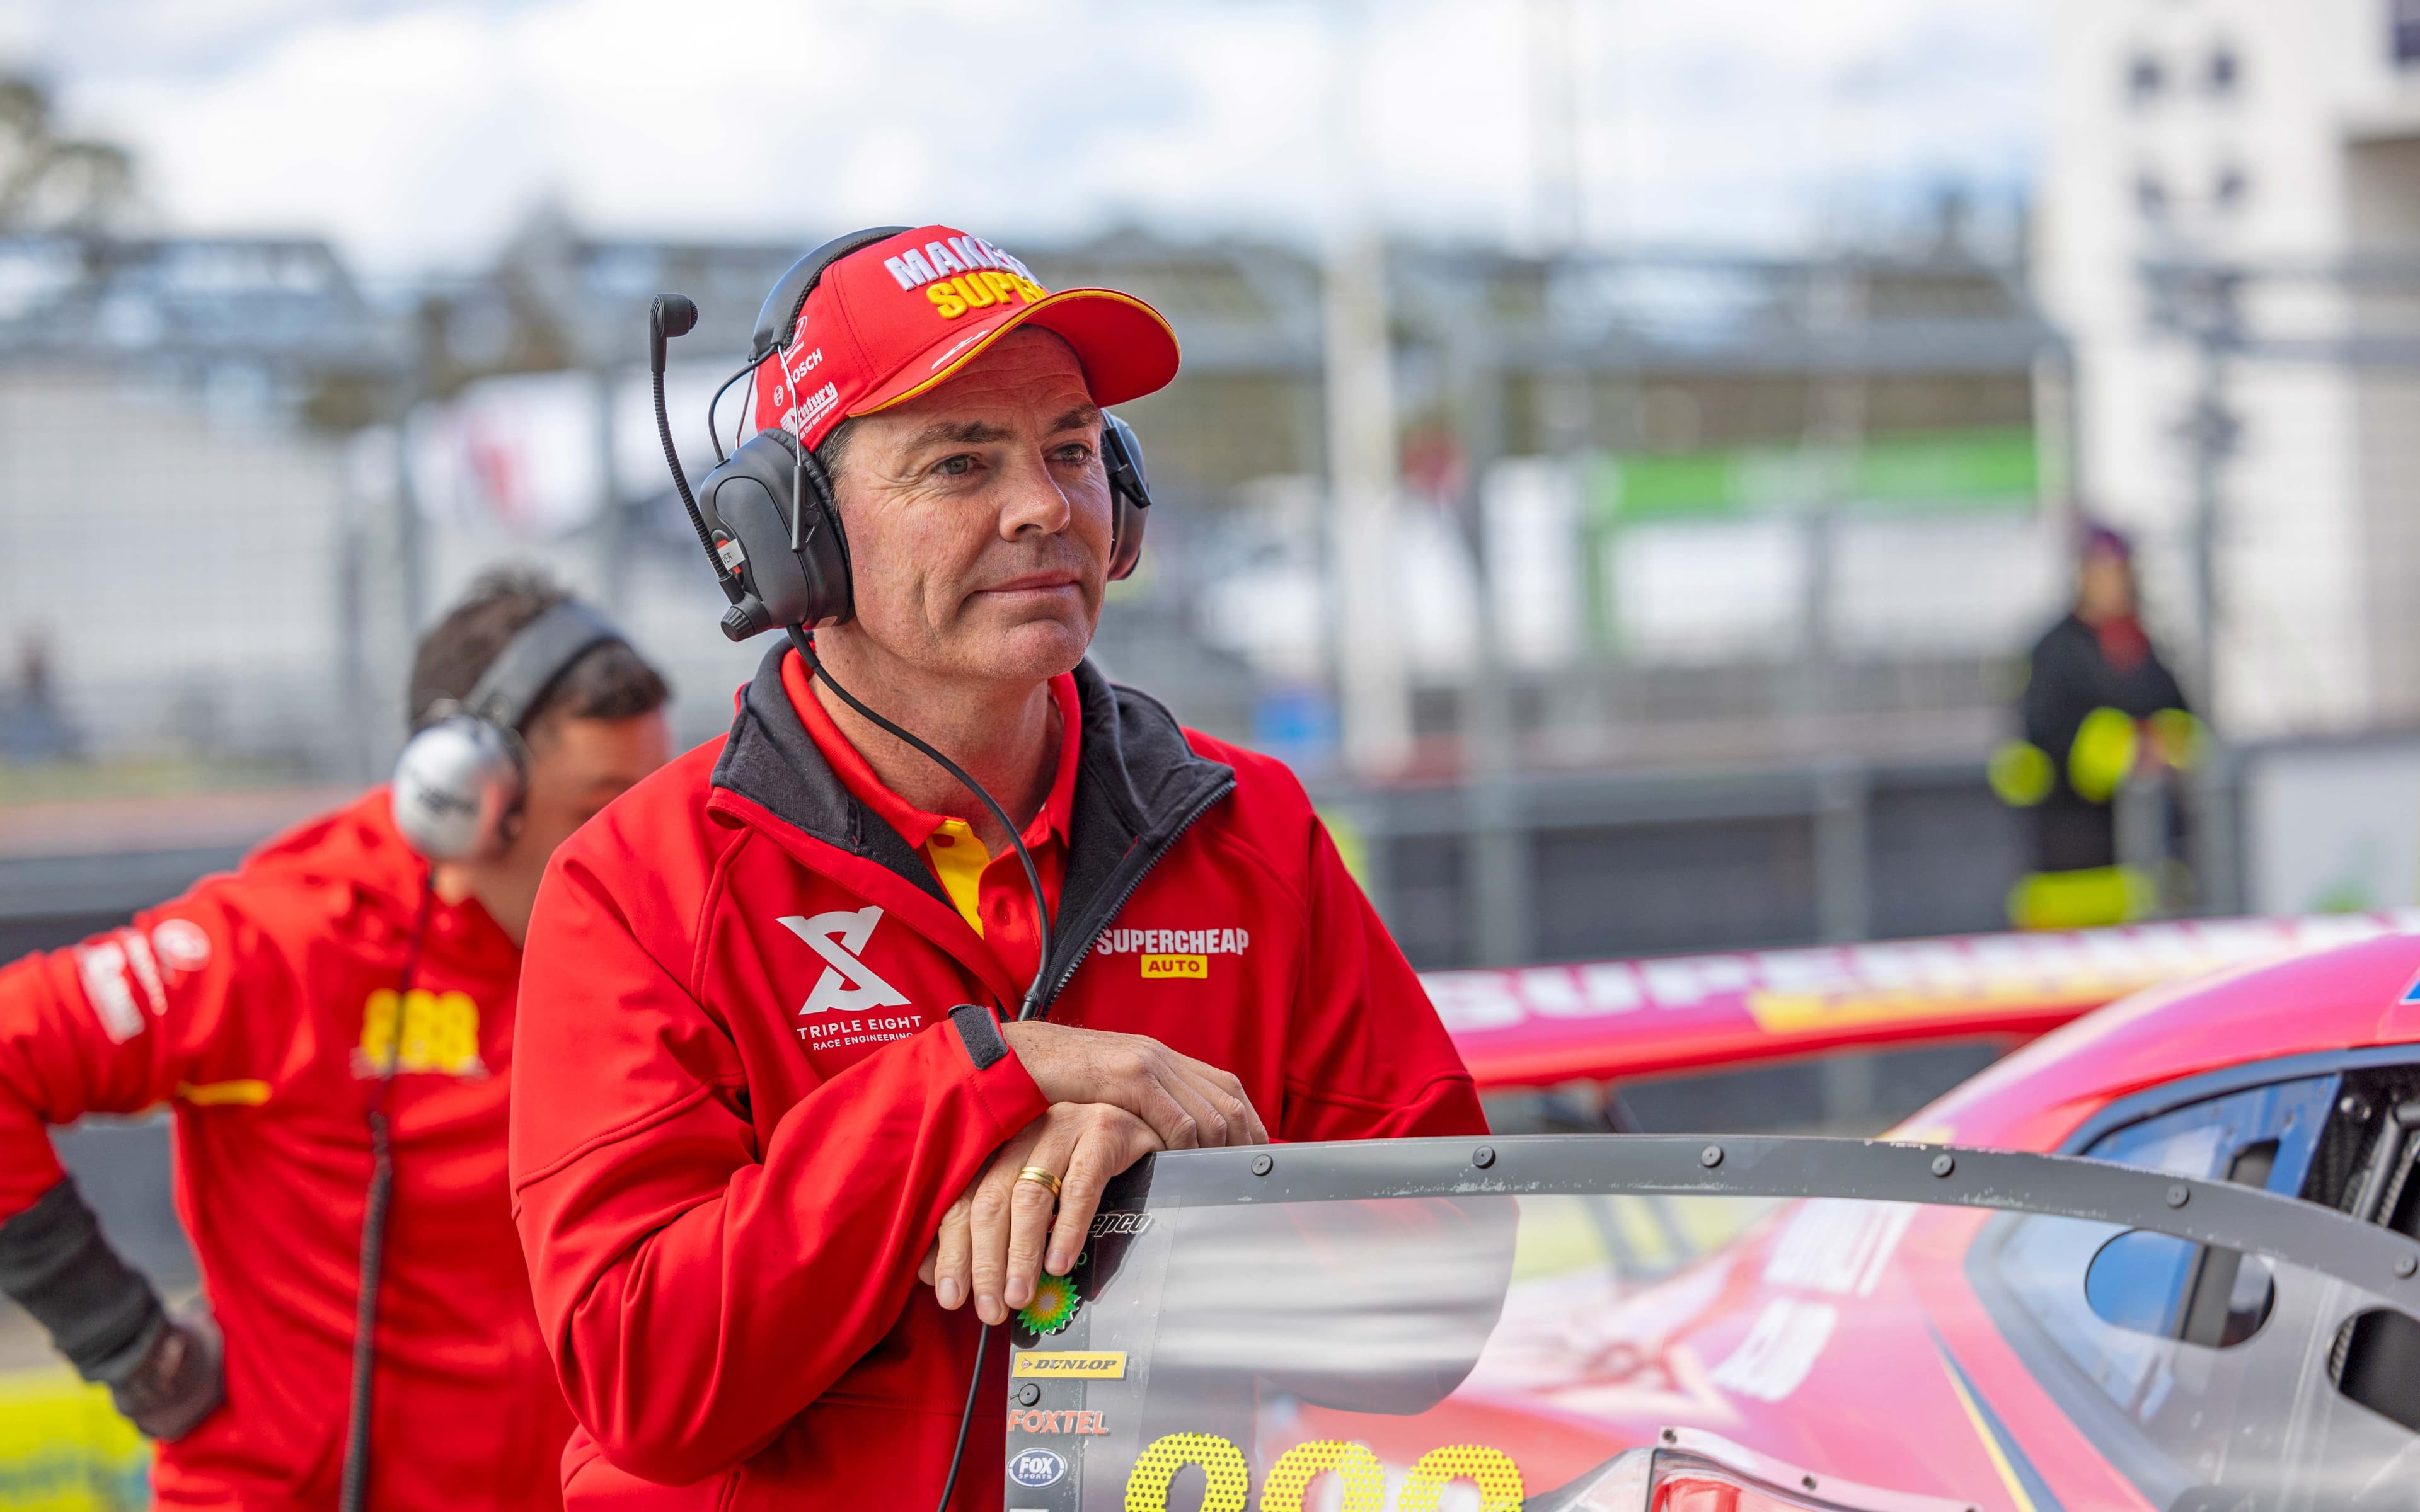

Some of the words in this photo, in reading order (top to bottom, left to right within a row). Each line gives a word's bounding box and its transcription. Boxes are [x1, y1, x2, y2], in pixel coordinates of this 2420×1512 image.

[884, 235, 1013, 292] MAKE
[1097, 928, 1249, 955] SUPERCHEAP
[1148, 960, 1200, 972] AUTO
[797, 1020, 862, 1040] TRIPLE
[868, 1016, 921, 1031] EIGHT
[813, 1039, 841, 1051] RACE
[1087, 1213, 1153, 1237] epco
[1034, 1360, 1117, 1370] DUNLOP
[1008, 1409, 1109, 1435] FOXTEL
[1019, 1457, 1055, 1474] FOX
